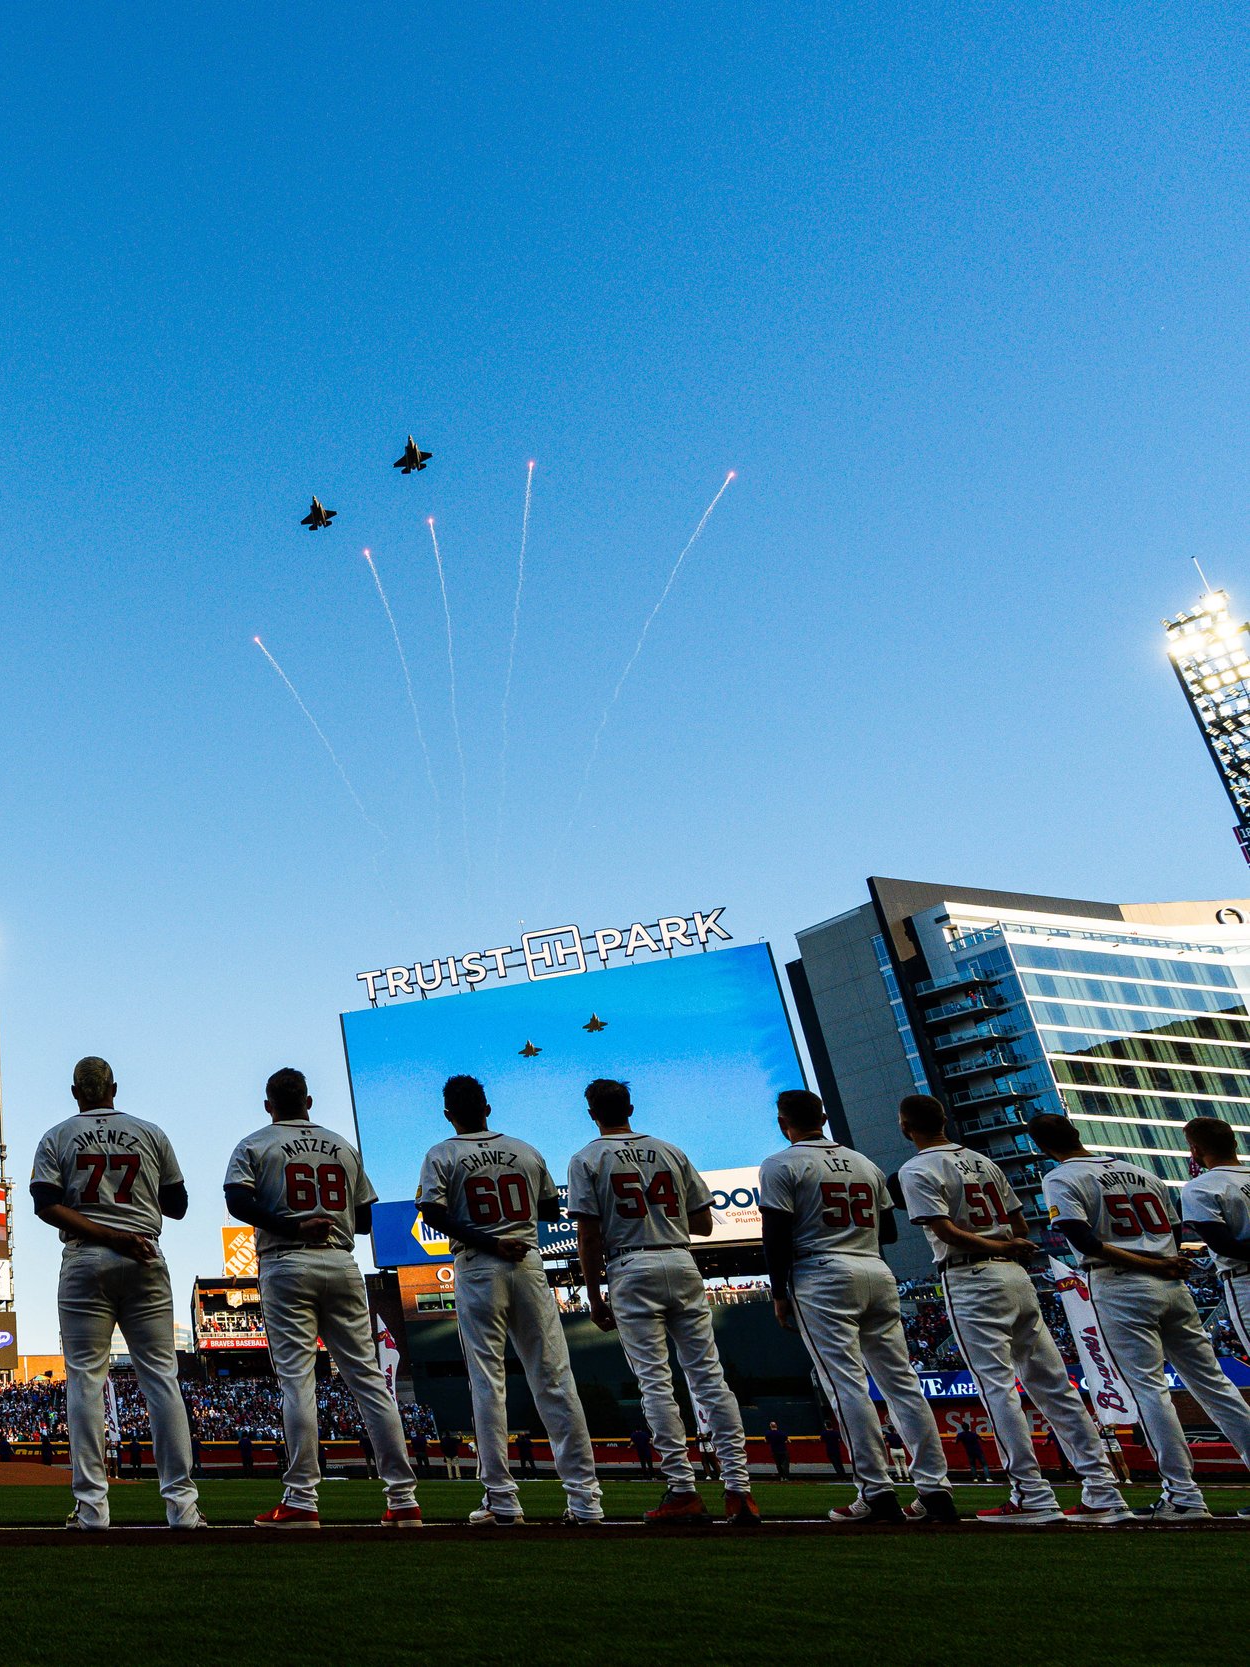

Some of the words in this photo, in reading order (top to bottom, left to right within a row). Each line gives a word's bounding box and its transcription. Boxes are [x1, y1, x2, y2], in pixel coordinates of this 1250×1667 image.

[357, 945, 512, 1001] TRUIST
[594, 906, 733, 960] PARK
[72, 1125, 141, 1152] JIMÉNEZ
[281, 1138, 342, 1160] MATZEK
[614, 1148, 657, 1165] FRIED
[75, 1153, 141, 1204] 77
[461, 1150, 518, 1172] CHAVEZ
[823, 1158, 853, 1174] LEE
[954, 1160, 985, 1176] SALE
[285, 1162, 347, 1212] 68
[464, 1173, 532, 1225] 60
[610, 1170, 680, 1219] 54
[1097, 1171, 1146, 1191] MORTON
[725, 1209, 758, 1218] Cooling
[820, 1182, 874, 1228] 52
[963, 1181, 1011, 1227] 51
[1102, 1192, 1171, 1237] 50
[228, 1232, 248, 1252] THE
[1079, 1335, 1129, 1414] Braves
